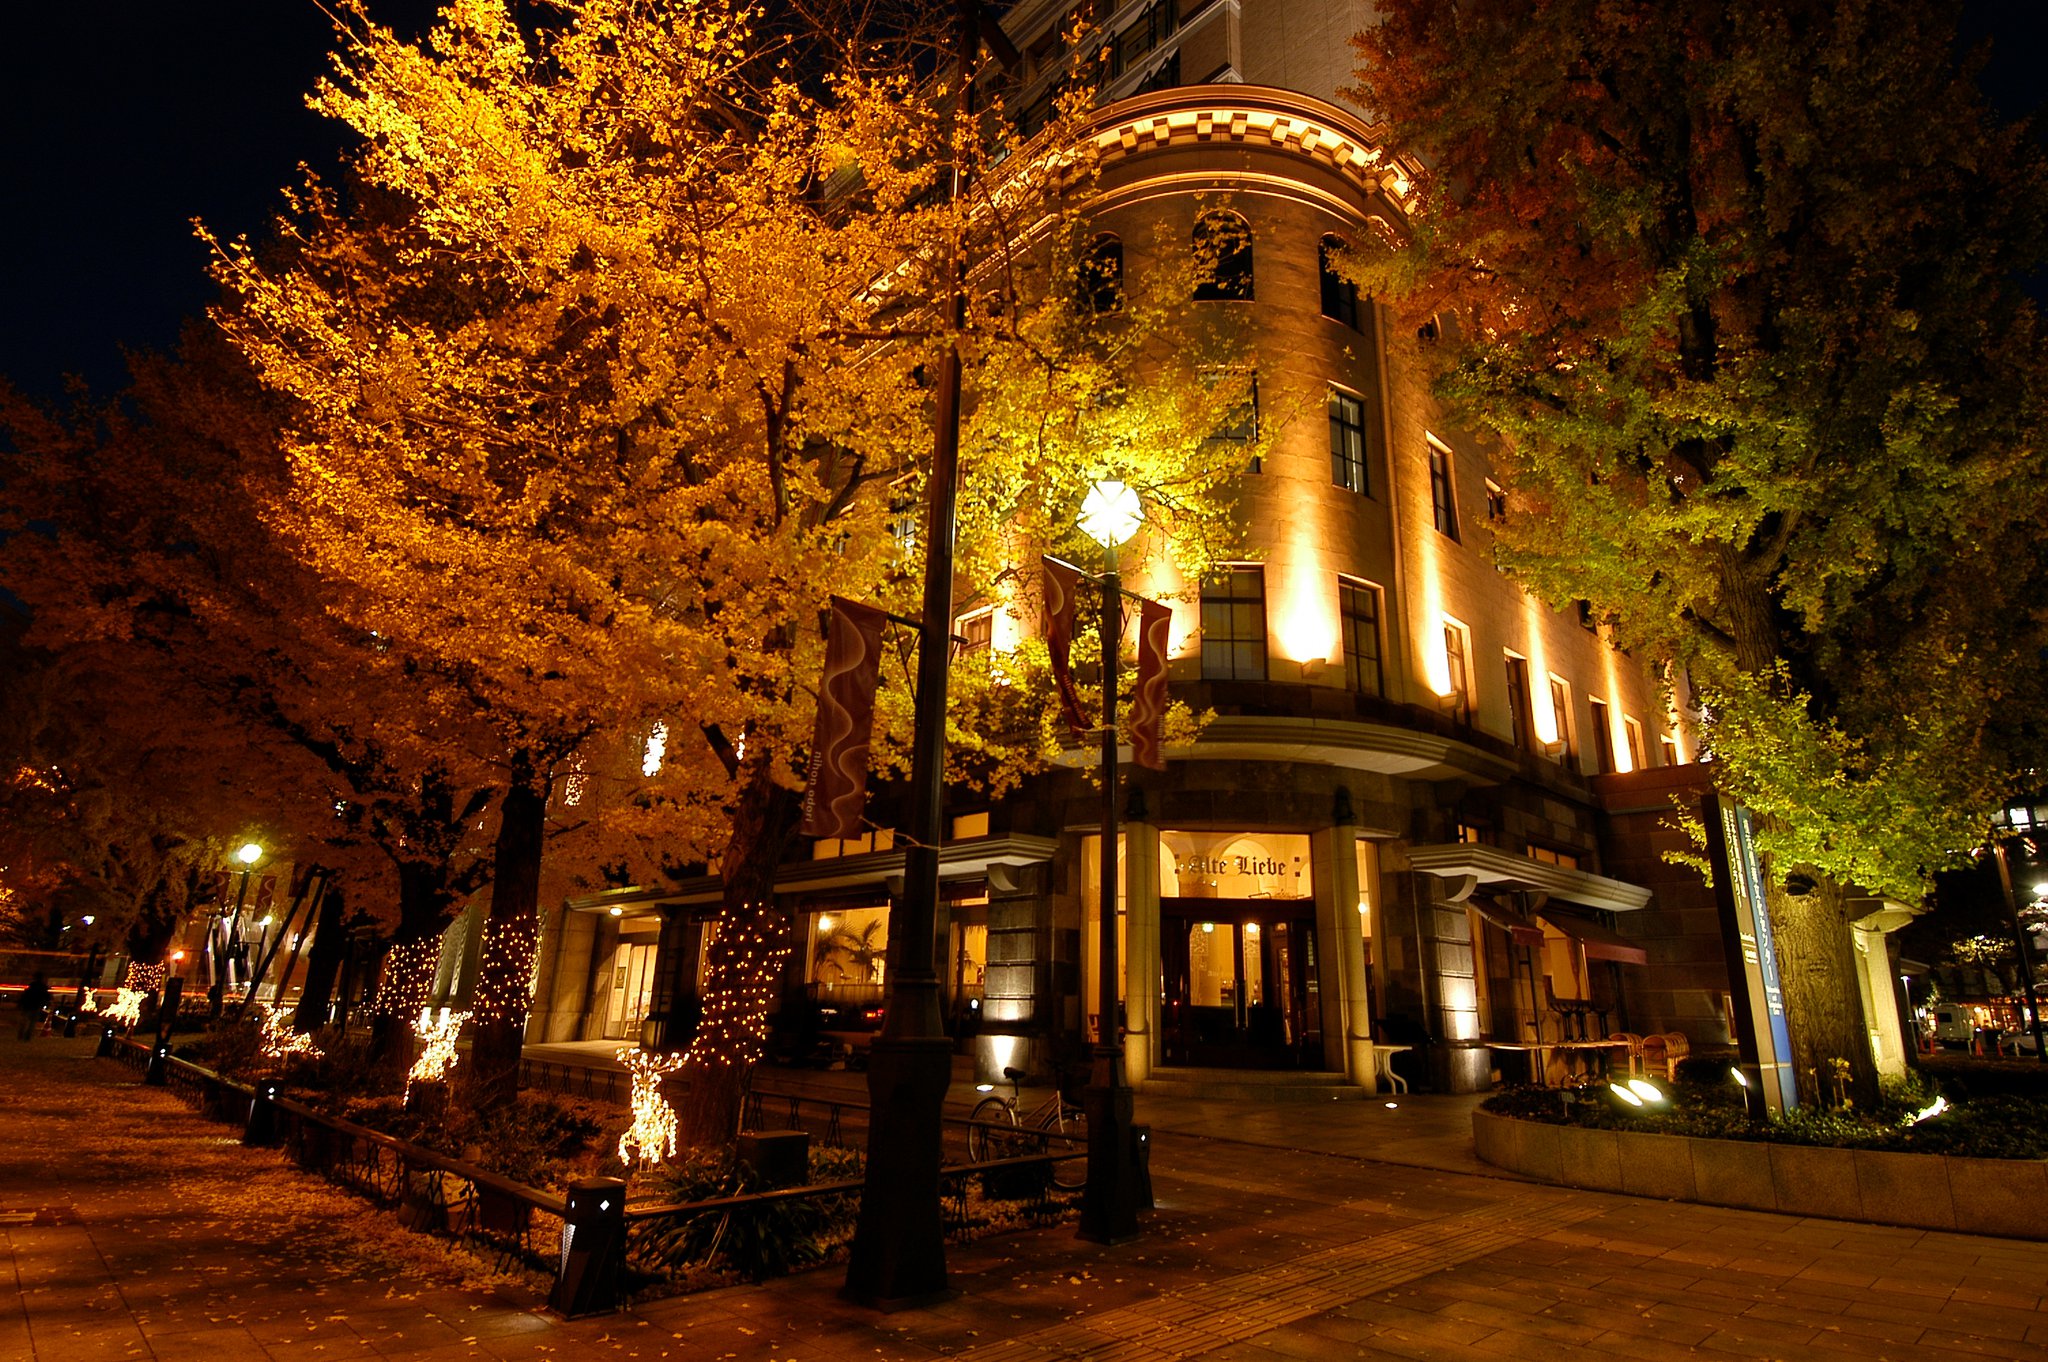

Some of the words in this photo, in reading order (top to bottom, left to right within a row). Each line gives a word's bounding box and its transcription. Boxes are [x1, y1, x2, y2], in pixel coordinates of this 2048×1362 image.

[810, 751, 822, 785] nihon
[805, 789, 816, 823] odori
[1188, 855, 1227, 875] Alte
[1236, 856, 1286, 876] Liebe
